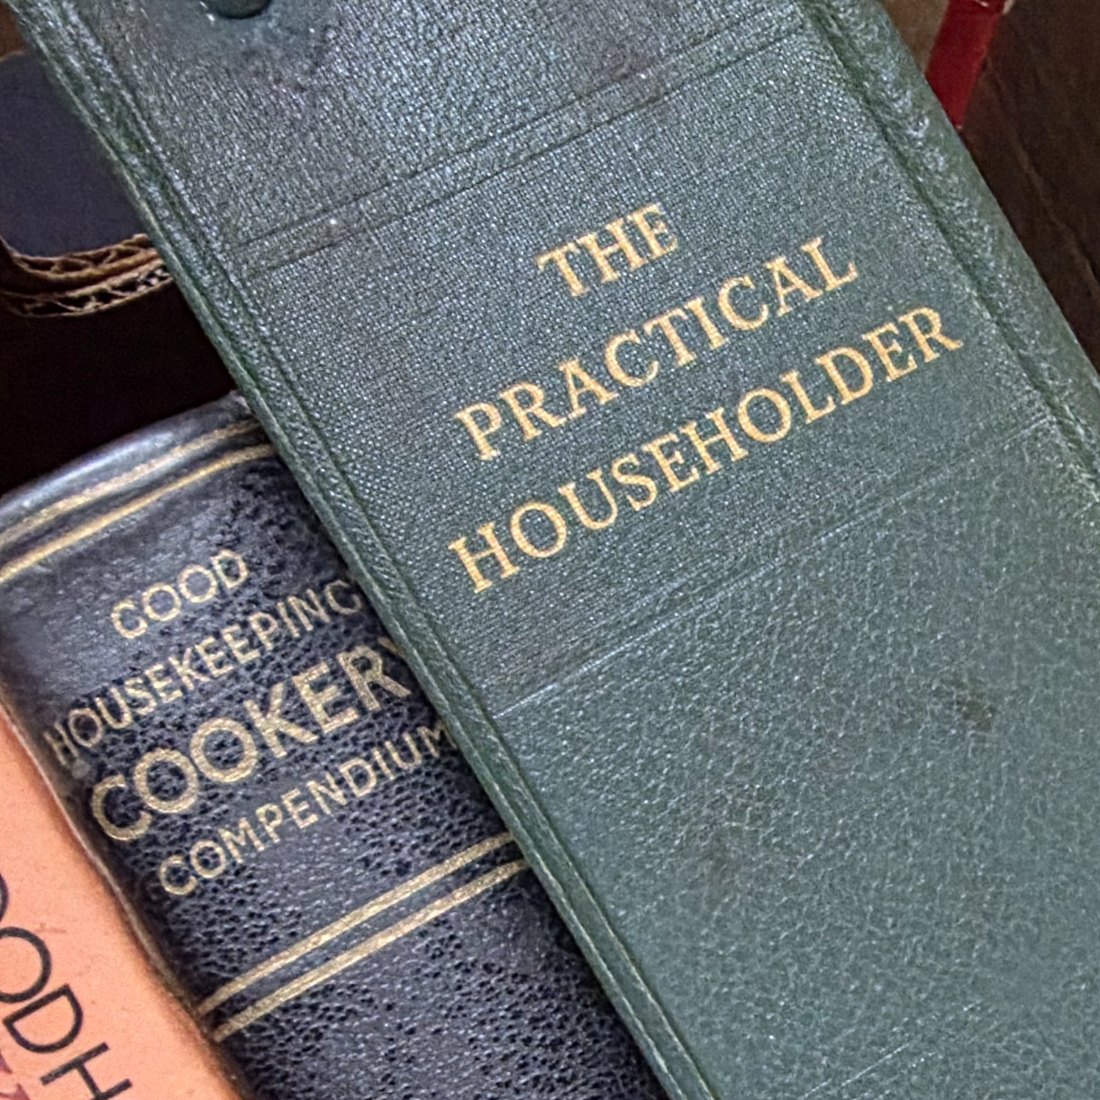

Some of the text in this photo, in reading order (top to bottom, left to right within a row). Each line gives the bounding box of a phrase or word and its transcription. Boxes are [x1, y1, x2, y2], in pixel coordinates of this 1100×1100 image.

[536, 203, 679, 298] THE
[454, 236, 859, 462] PRACTICAL
[448, 305, 963, 594] HOUSEHOLDER
[43, 578, 363, 768] HOUSEKEEPING
[110, 548, 249, 640] GOOD
[91, 635, 412, 842] COOKER
[158, 720, 459, 896] COMPENDIUM
[0, 872, 84, 1054] OD
